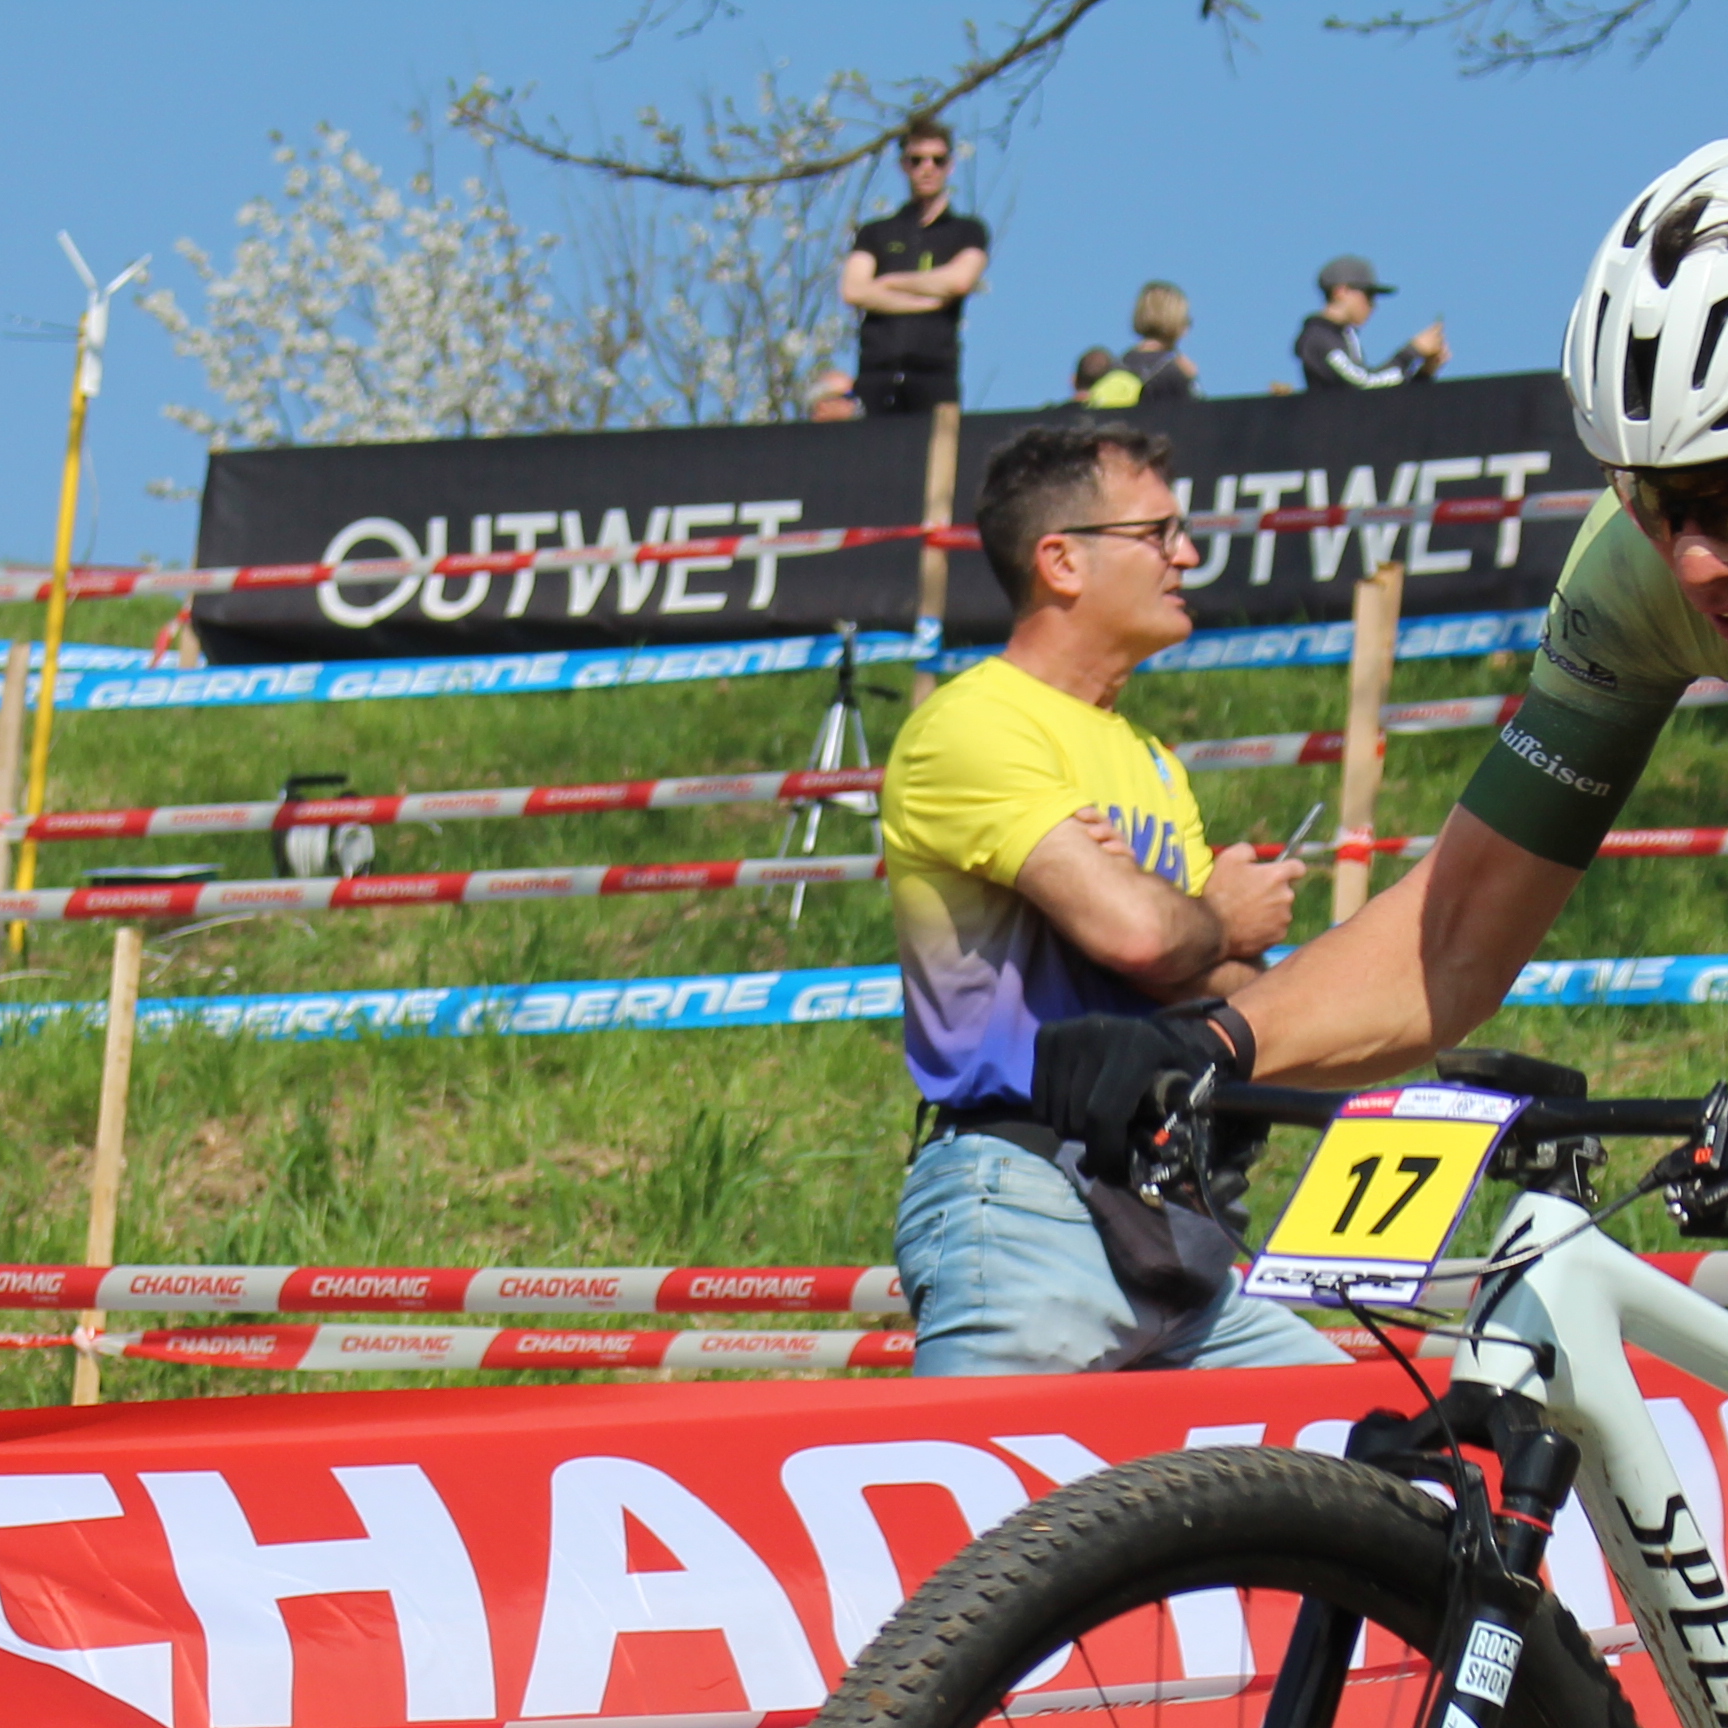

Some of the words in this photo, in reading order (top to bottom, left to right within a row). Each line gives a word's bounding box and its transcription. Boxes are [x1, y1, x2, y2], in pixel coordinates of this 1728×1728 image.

[1175, 451, 1552, 590] UTWET
[318, 499, 804, 628] OUTWET
[329, 652, 569, 700] GAERNE
[574, 637, 818, 688] GAERNE
[86, 661, 323, 709] GAERNE
[1500, 721, 1612, 797] aiffeisen
[1605, 829, 1695, 847] HAOYANG
[458, 973, 780, 1036] GAERNE
[1330, 1152, 1444, 1236] 17
[129, 1273, 245, 1298] CHAOYANG
[311, 1275, 431, 1300] CHAOYANG
[500, 1276, 619, 1301] CHAOYANG
[690, 1276, 815, 1301] CHAOYANG
[341, 1333, 455, 1357] CHAOYANG
[516, 1333, 635, 1356] CHAOYANG
[702, 1334, 821, 1356] CHAOYANG
[1471, 1628, 1522, 1672] ROCK
